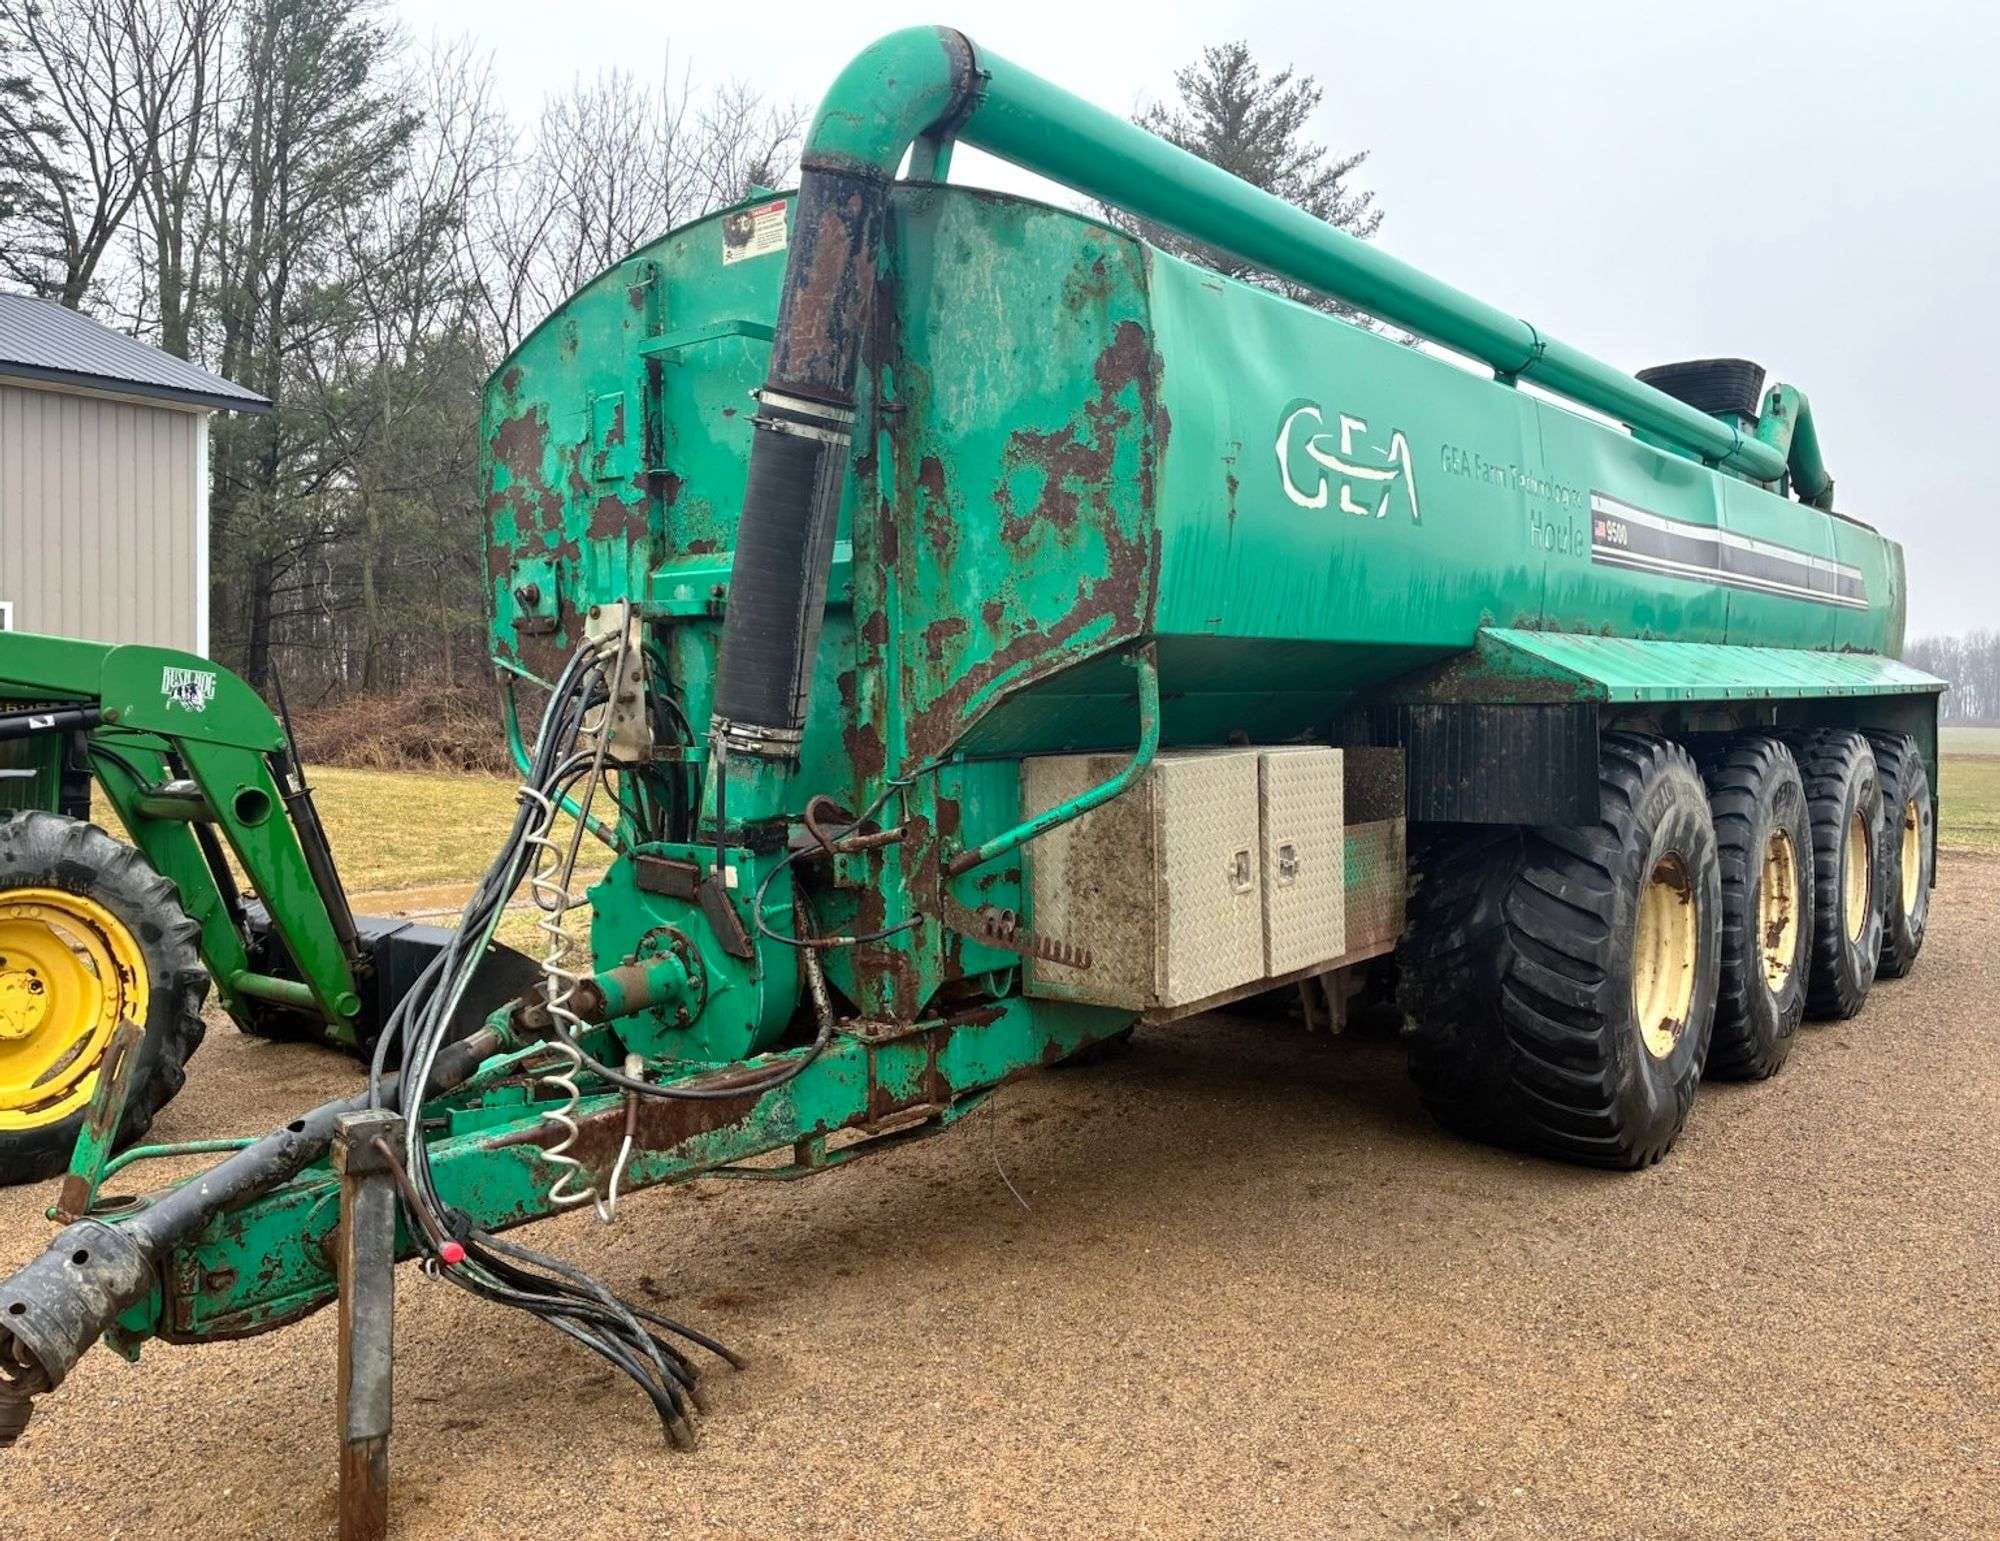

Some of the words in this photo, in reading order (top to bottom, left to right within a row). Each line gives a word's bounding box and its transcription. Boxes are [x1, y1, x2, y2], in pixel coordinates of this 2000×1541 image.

[1275, 399, 1421, 526] GEA
[1441, 443, 1471, 478] GEA
[1474, 453, 1506, 489] Farm
[1530, 509, 1583, 557] Houle
